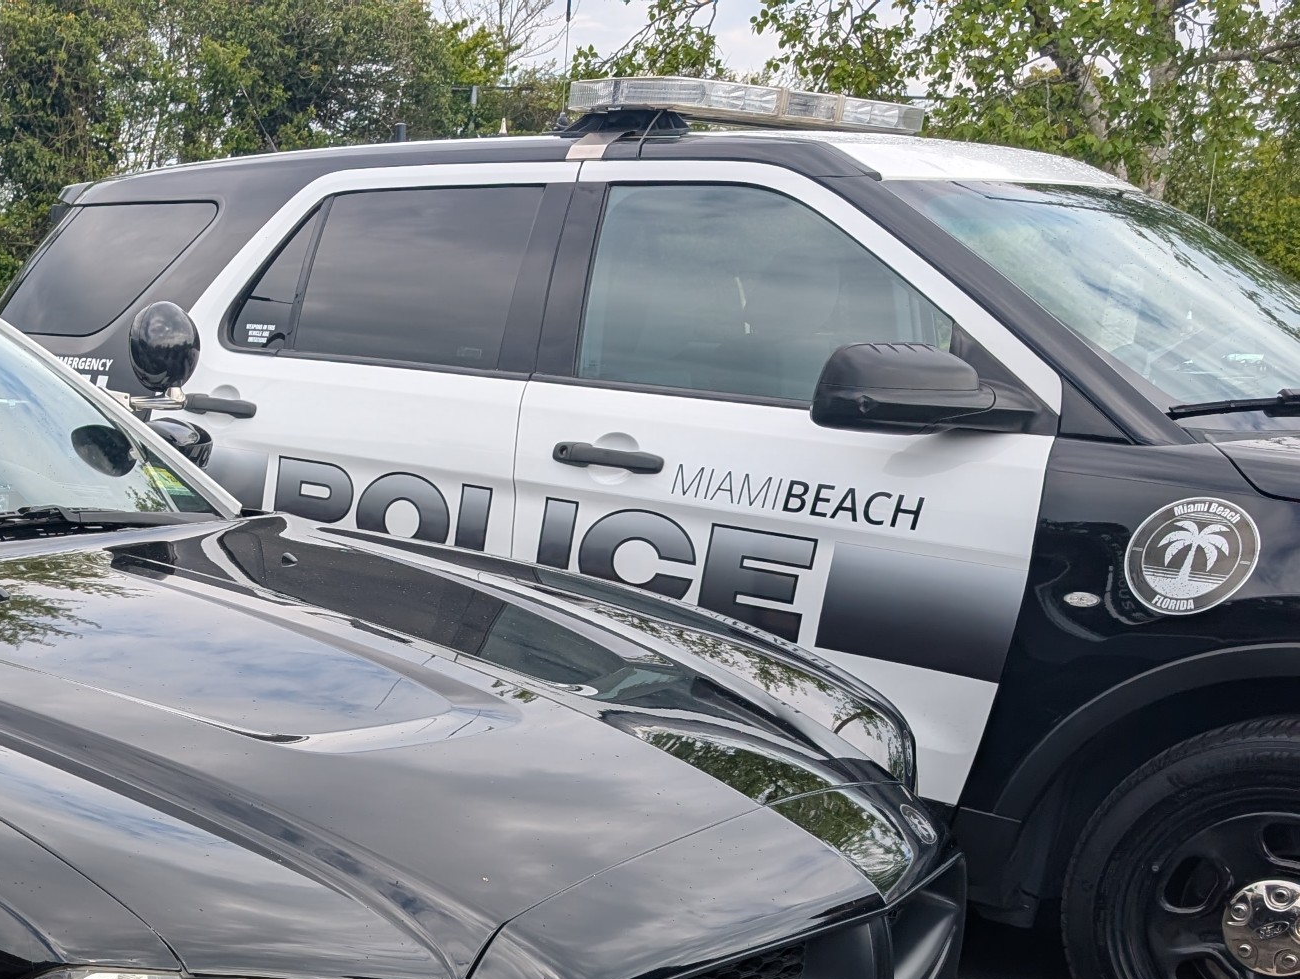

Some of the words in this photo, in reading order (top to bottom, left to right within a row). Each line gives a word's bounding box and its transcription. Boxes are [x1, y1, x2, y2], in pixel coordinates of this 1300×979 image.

[56, 356, 113, 371] MERGENCY
[1173, 502, 1209, 516] Miami
[1209, 502, 1241, 525] Beach
[1151, 594, 1194, 610] FLORIDA
